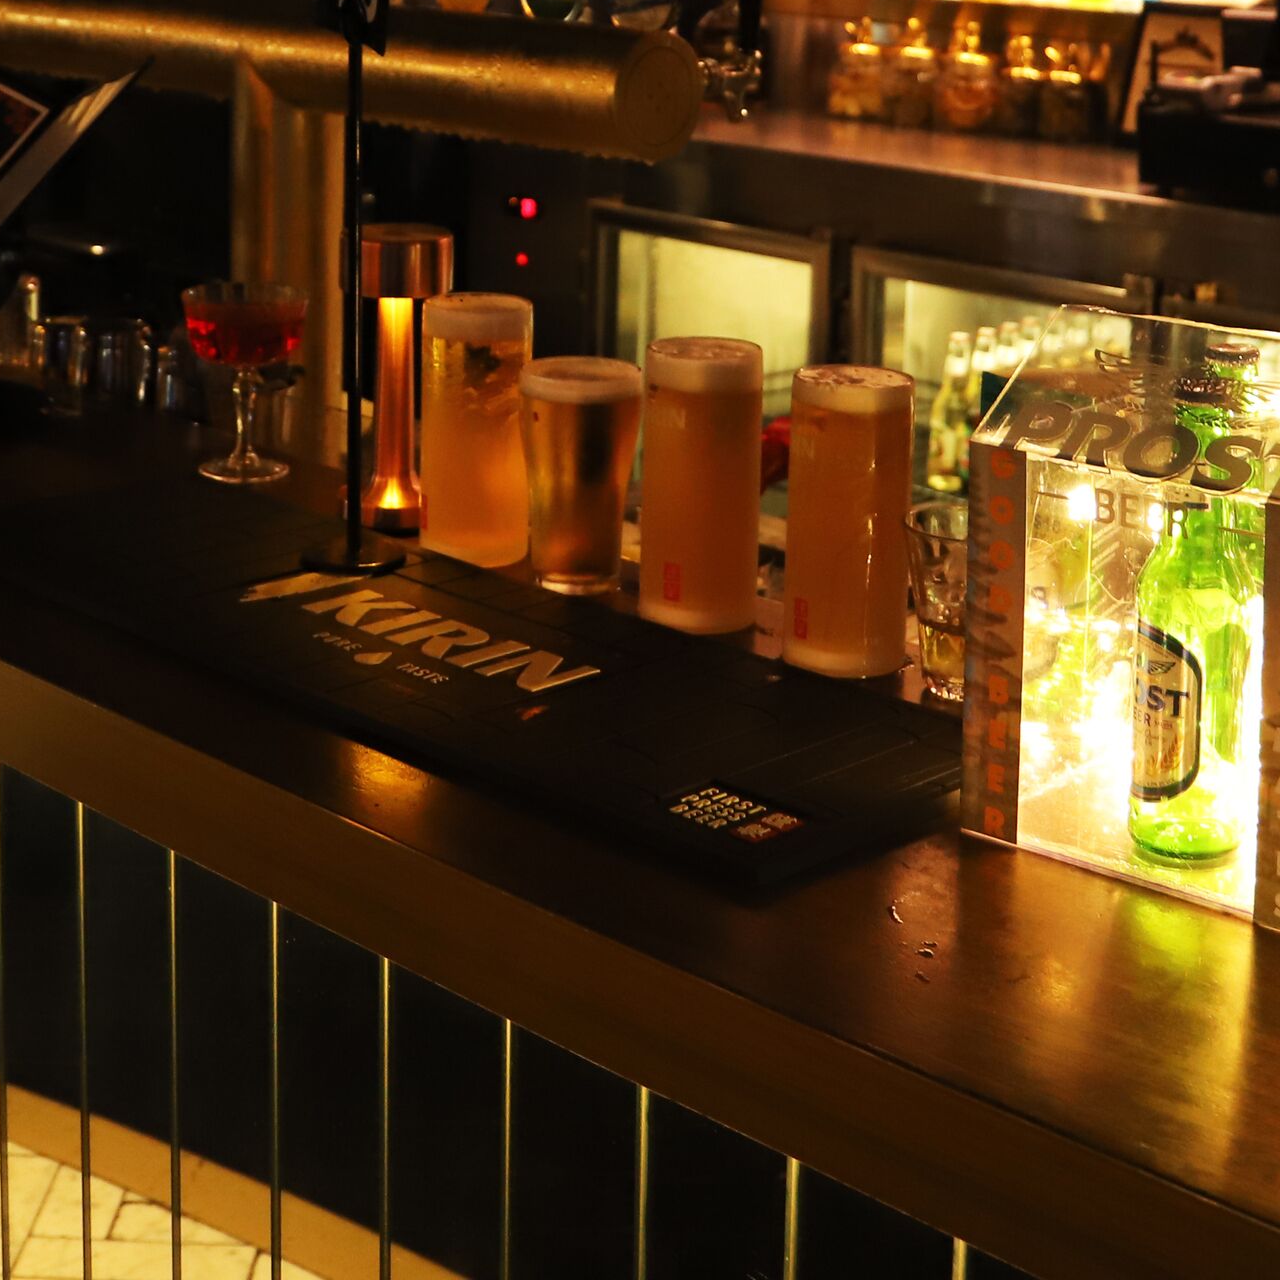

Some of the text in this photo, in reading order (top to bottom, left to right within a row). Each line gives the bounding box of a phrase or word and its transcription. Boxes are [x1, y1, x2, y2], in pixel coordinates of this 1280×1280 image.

[1094, 487, 1189, 539] BER
[301, 589, 601, 693] KIRIN
[311, 631, 364, 652] PURE
[983, 451, 1016, 838] GOOD BEER
[395, 662, 450, 685] TASTE
[680, 793, 747, 822] PRESS
[699, 787, 767, 815] FIRST
[669, 803, 728, 830] BEER
